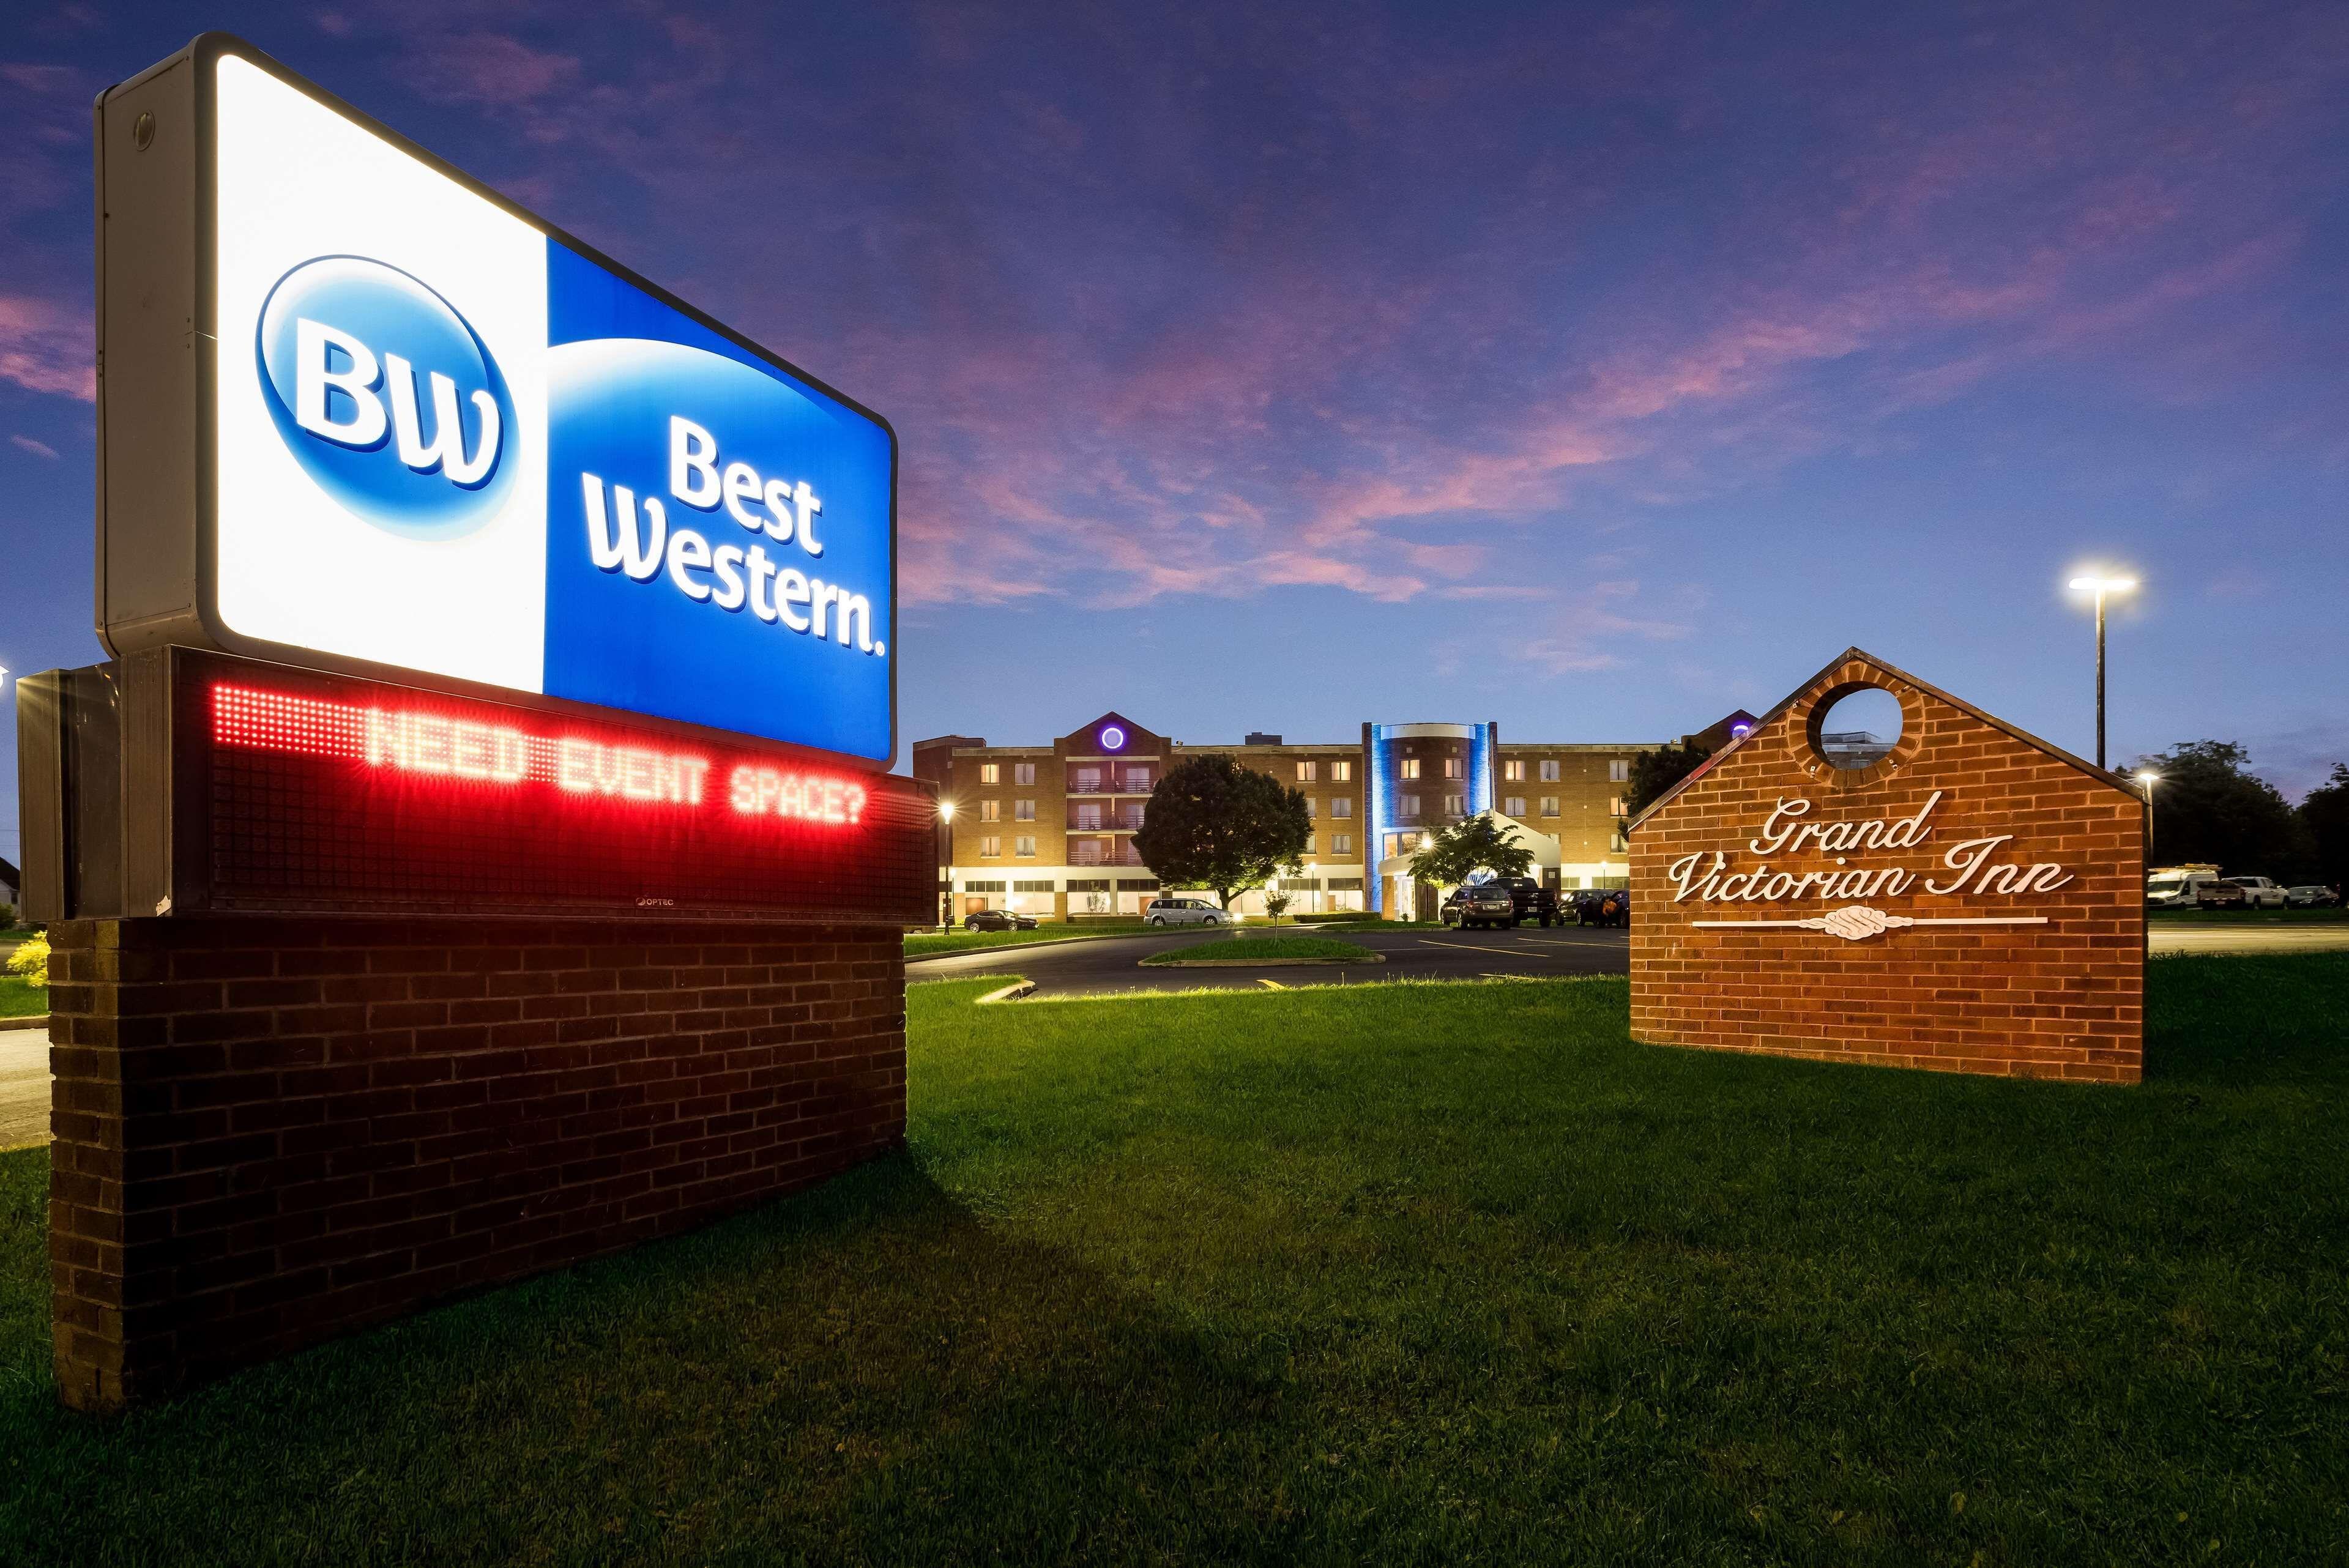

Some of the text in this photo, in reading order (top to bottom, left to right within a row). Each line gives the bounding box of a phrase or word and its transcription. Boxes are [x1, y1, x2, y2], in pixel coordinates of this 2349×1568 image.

[296, 317, 501, 485] BW
[670, 415, 823, 555] Best
[582, 472, 873, 653] Western
[369, 707, 866, 824] NEED EVENT SPACE?
[1749, 790, 1942, 855] Grand
[1668, 834, 2074, 902] Victorian Inn
